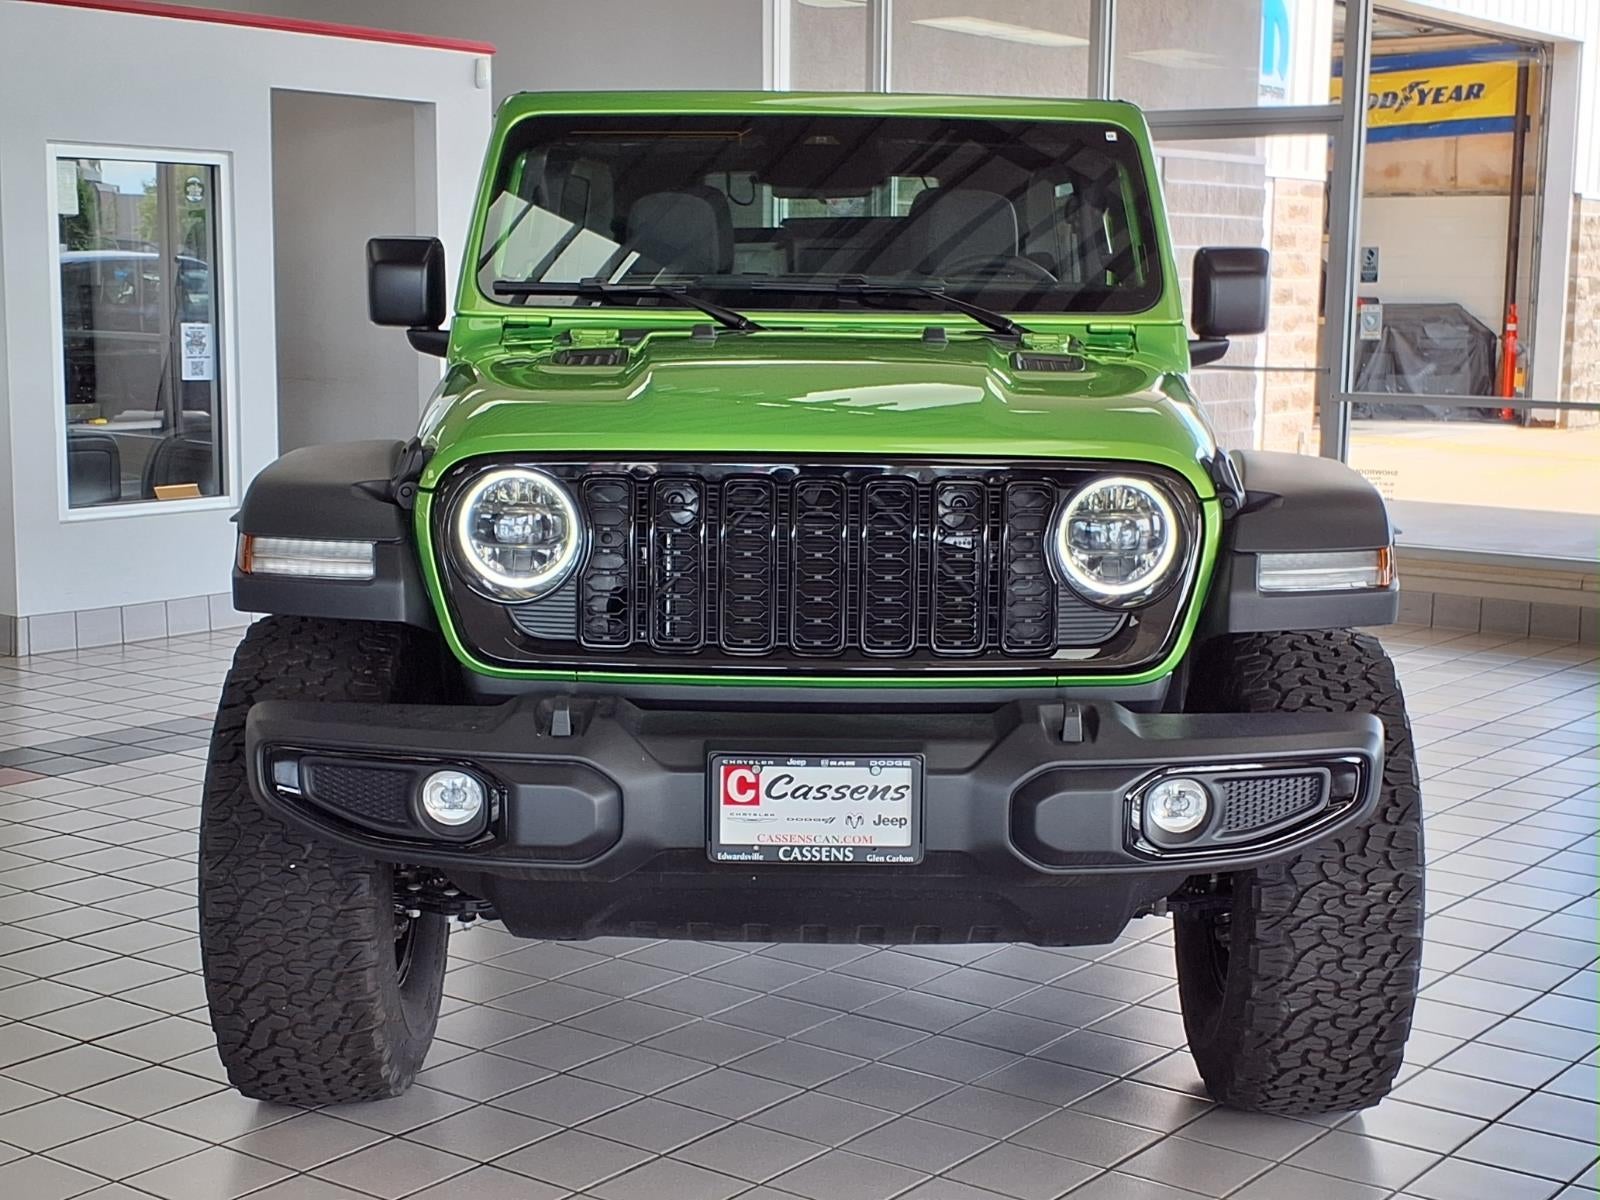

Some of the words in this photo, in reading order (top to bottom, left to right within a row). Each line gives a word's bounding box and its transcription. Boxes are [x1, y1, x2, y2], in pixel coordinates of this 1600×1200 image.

[1368, 82, 1485, 112] ODYEAR
[786, 758, 807, 766] Jeep
[727, 768, 756, 803] C
[765, 773, 911, 801] Cassens
[873, 814, 908, 829] Jeep
[757, 834, 873, 845] CASSENSCAN.COM
[717, 852, 764, 861] Edwardsville
[778, 846, 854, 862] CASSENS
[866, 854, 885, 863] Glen
[886, 855, 914, 863] Carbon
